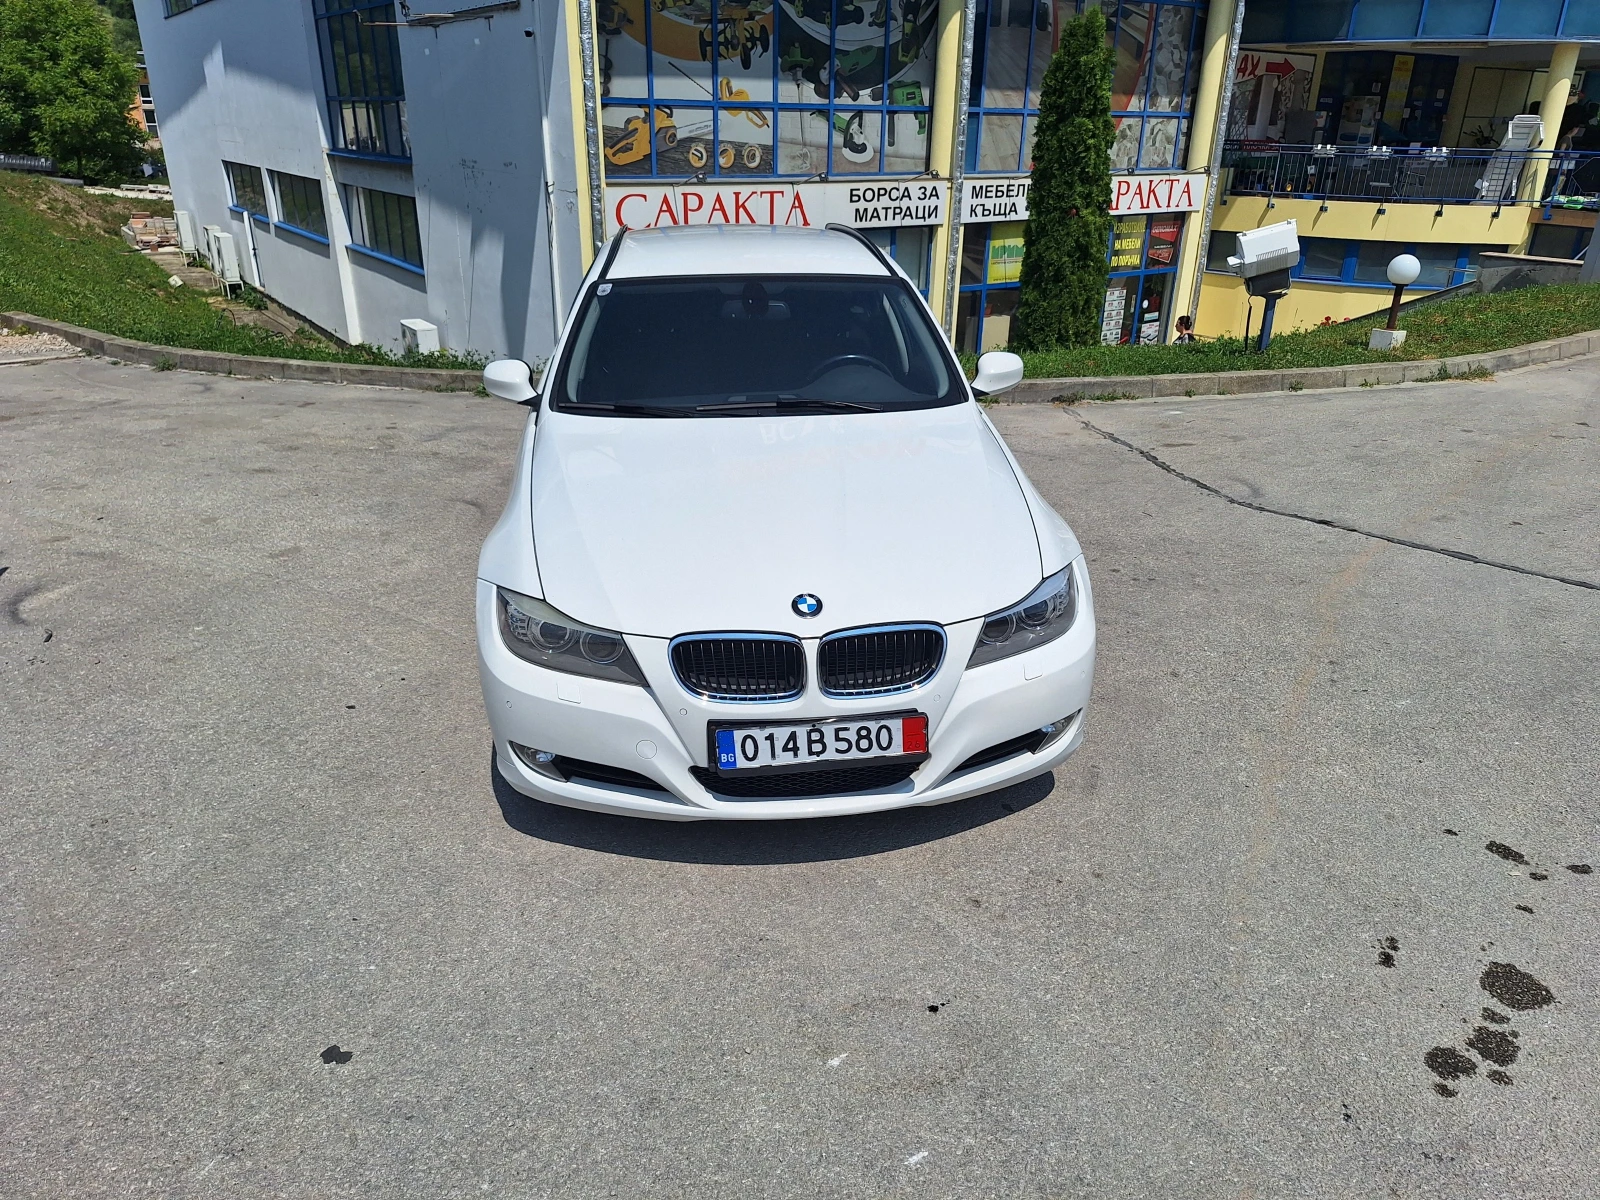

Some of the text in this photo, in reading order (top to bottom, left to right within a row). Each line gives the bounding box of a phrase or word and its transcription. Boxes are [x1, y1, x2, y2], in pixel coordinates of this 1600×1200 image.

[850, 186, 940, 203] БОРСА ЗА
[1109, 178, 1193, 211] РАКТА
[615, 190, 811, 231] САРАКТА
[854, 205, 939, 222] МАТРАЦИ
[970, 202, 1018, 219] КЪЩА
[740, 724, 893, 762] 014B580
[721, 753, 735, 763] BG
